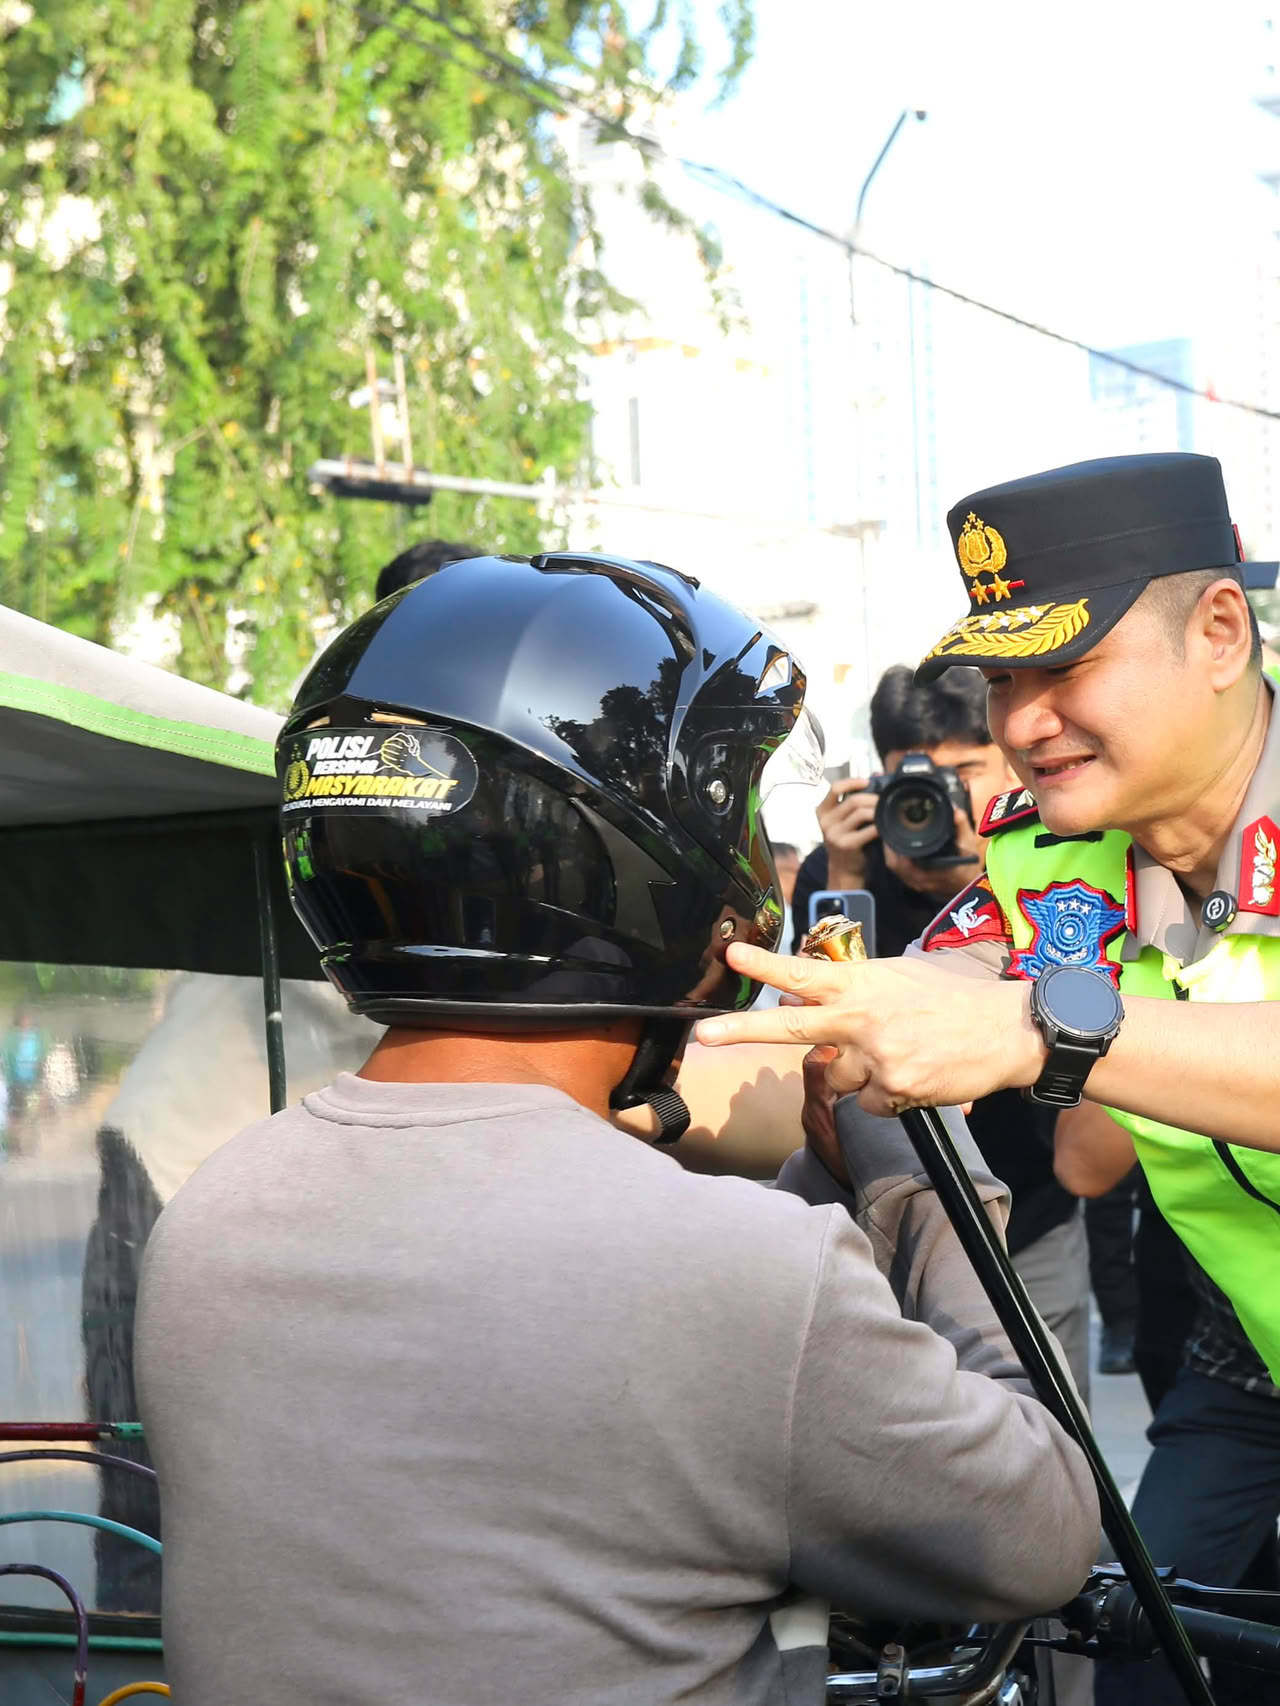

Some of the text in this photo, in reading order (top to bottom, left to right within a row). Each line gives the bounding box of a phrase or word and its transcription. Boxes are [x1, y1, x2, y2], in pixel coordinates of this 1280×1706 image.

[305, 735, 375, 761] POLISI
[313, 759, 380, 775] BERSAMA
[305, 775, 459, 799] MASYARAKAT
[312, 797, 366, 808] MENGAYOMI
[366, 799, 393, 808] DAN
[392, 799, 453, 811] MELAYANI
